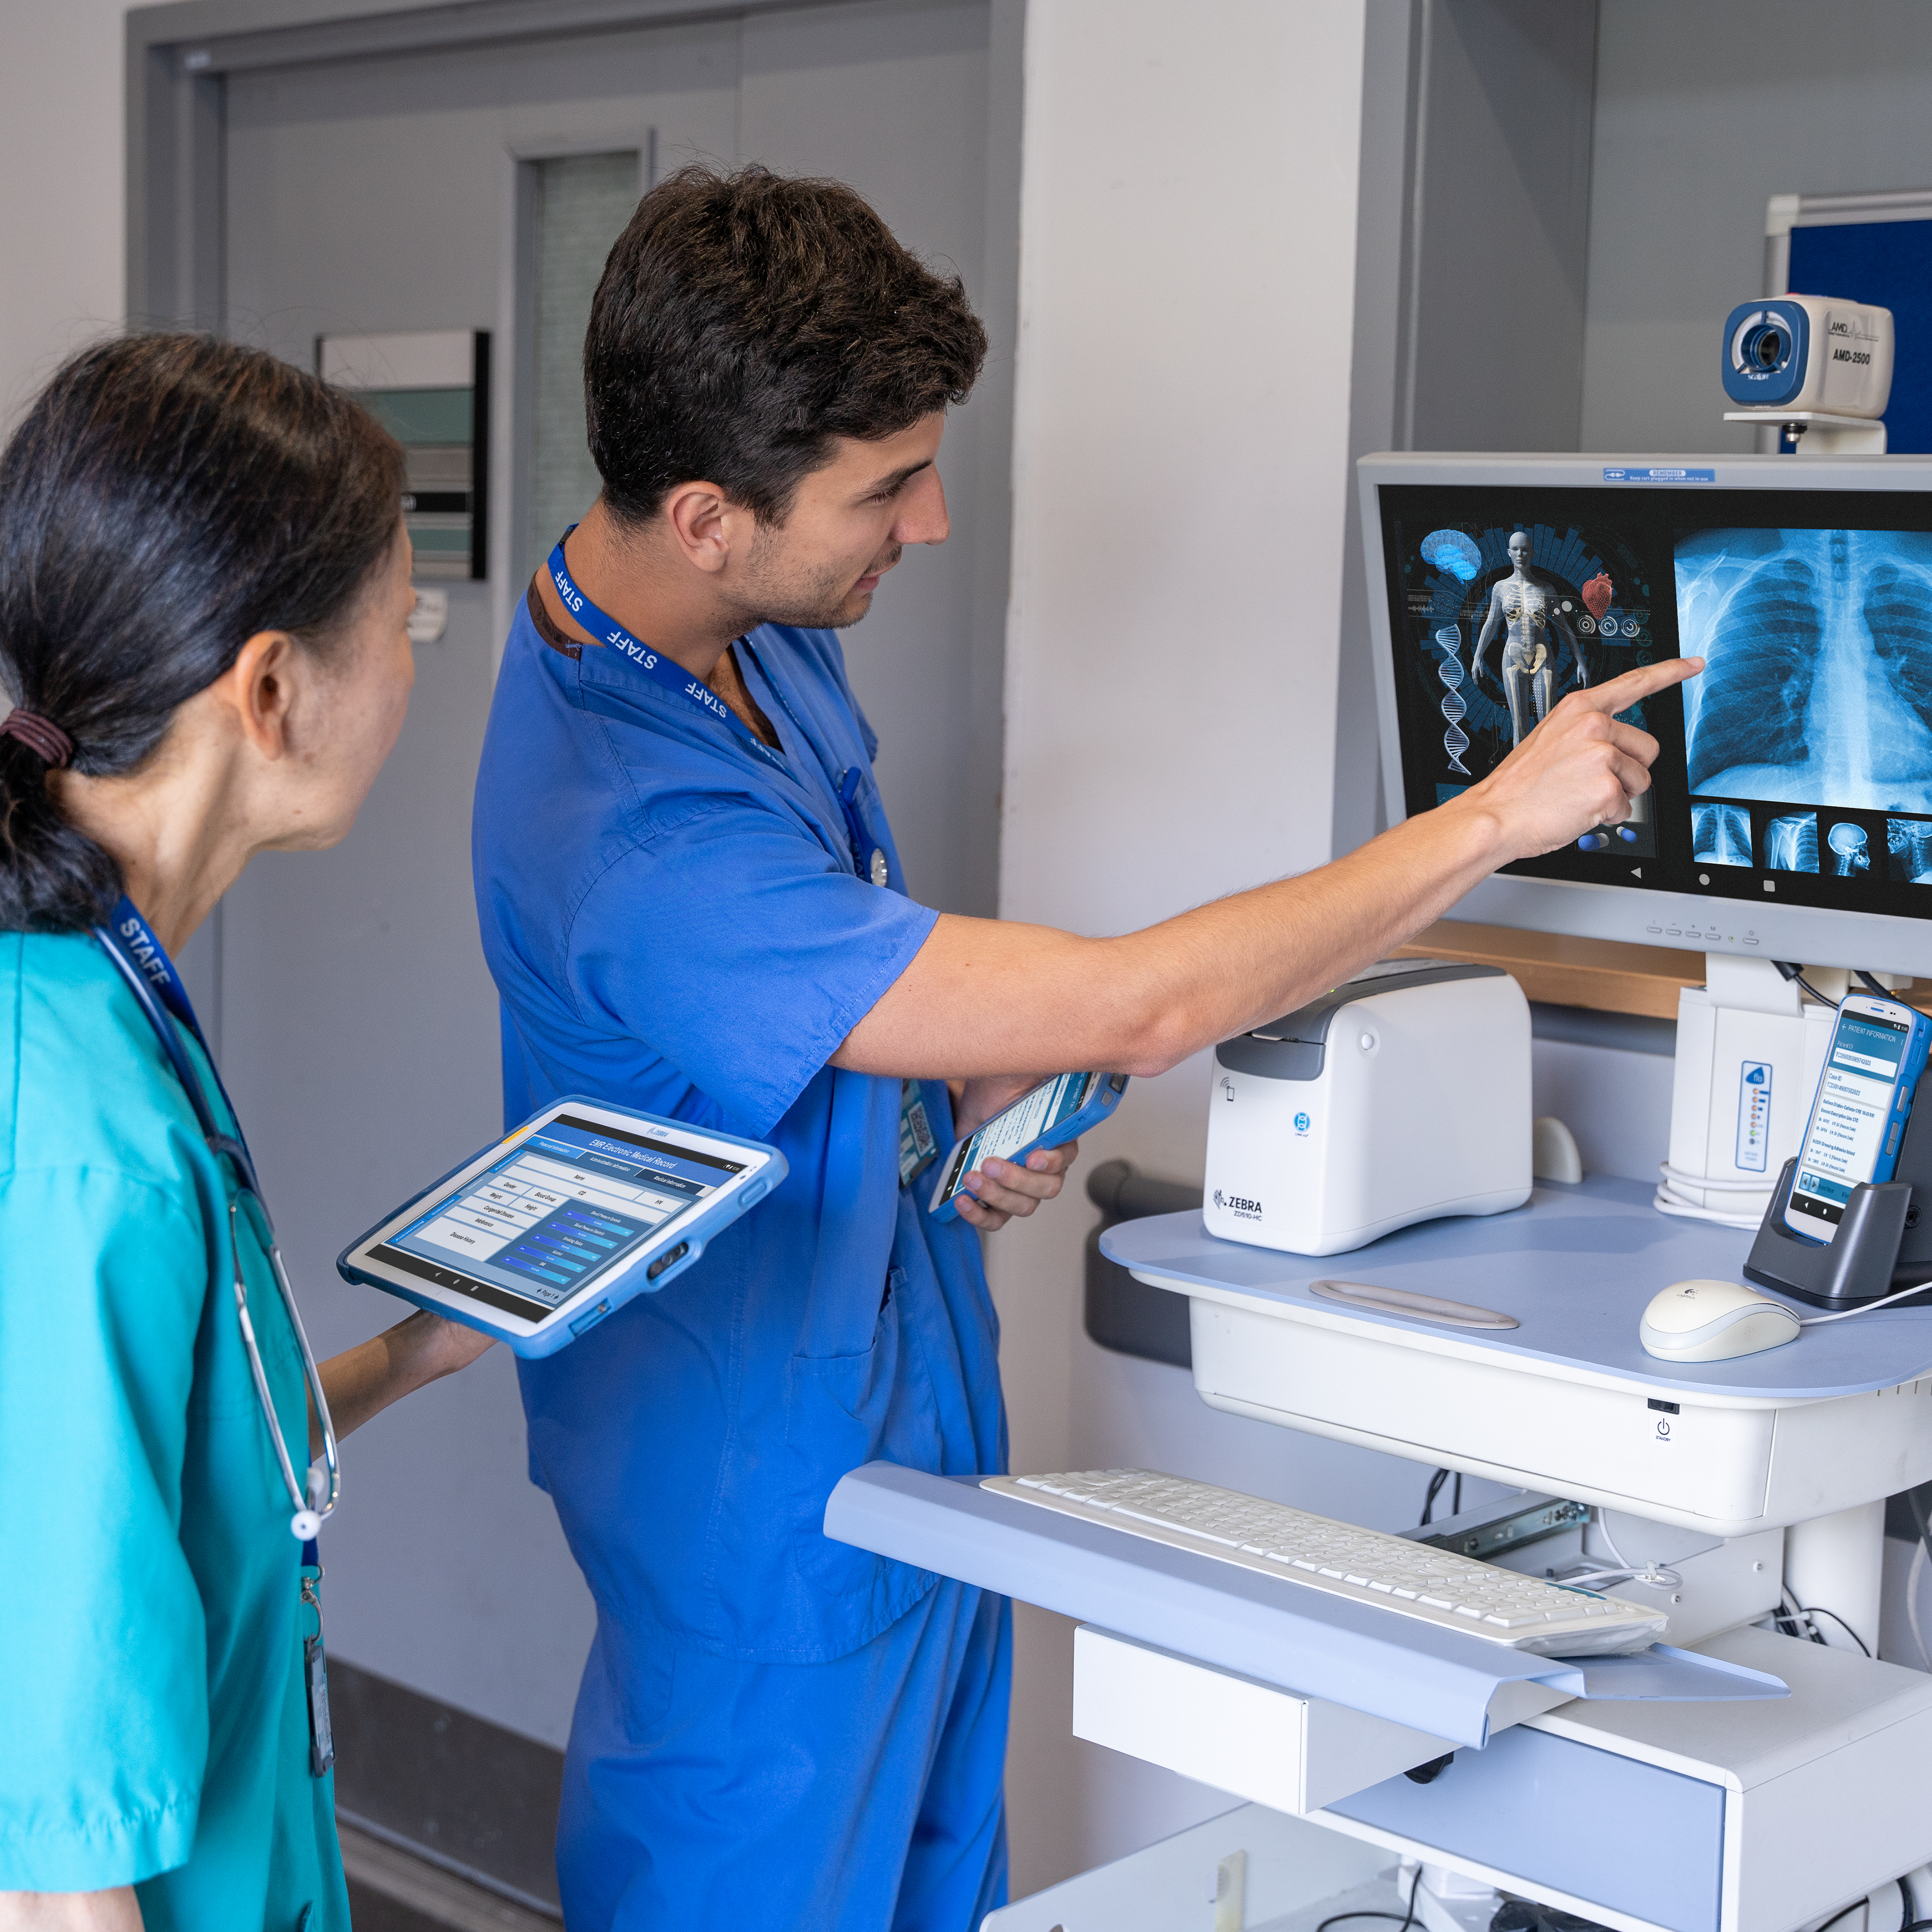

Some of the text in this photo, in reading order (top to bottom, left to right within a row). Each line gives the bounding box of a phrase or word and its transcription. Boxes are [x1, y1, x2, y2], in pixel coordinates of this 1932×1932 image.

[1832, 322, 1847, 333] AMD
[1833, 349, 1870, 365] AMD-2500
[555, 571, 583, 612] STAFF
[606, 631, 657, 670] STAFF
[685, 682, 727, 718] STAFF
[120, 918, 171, 984] STAFF
[1848, 1025, 1896, 1042] PATIENT INFORMATION
[589, 1139, 677, 1168] EMR Electronic Medical Record
[666, 1180, 686, 1188] Information
[482, 1206, 502, 1214] Congenital
[1229, 1196, 1262, 1213] ZEBRA
[474, 1218, 494, 1227] Intolerance
[1234, 1211, 1262, 1221] ZD510-HC
[540, 1290, 552, 1298] Page
